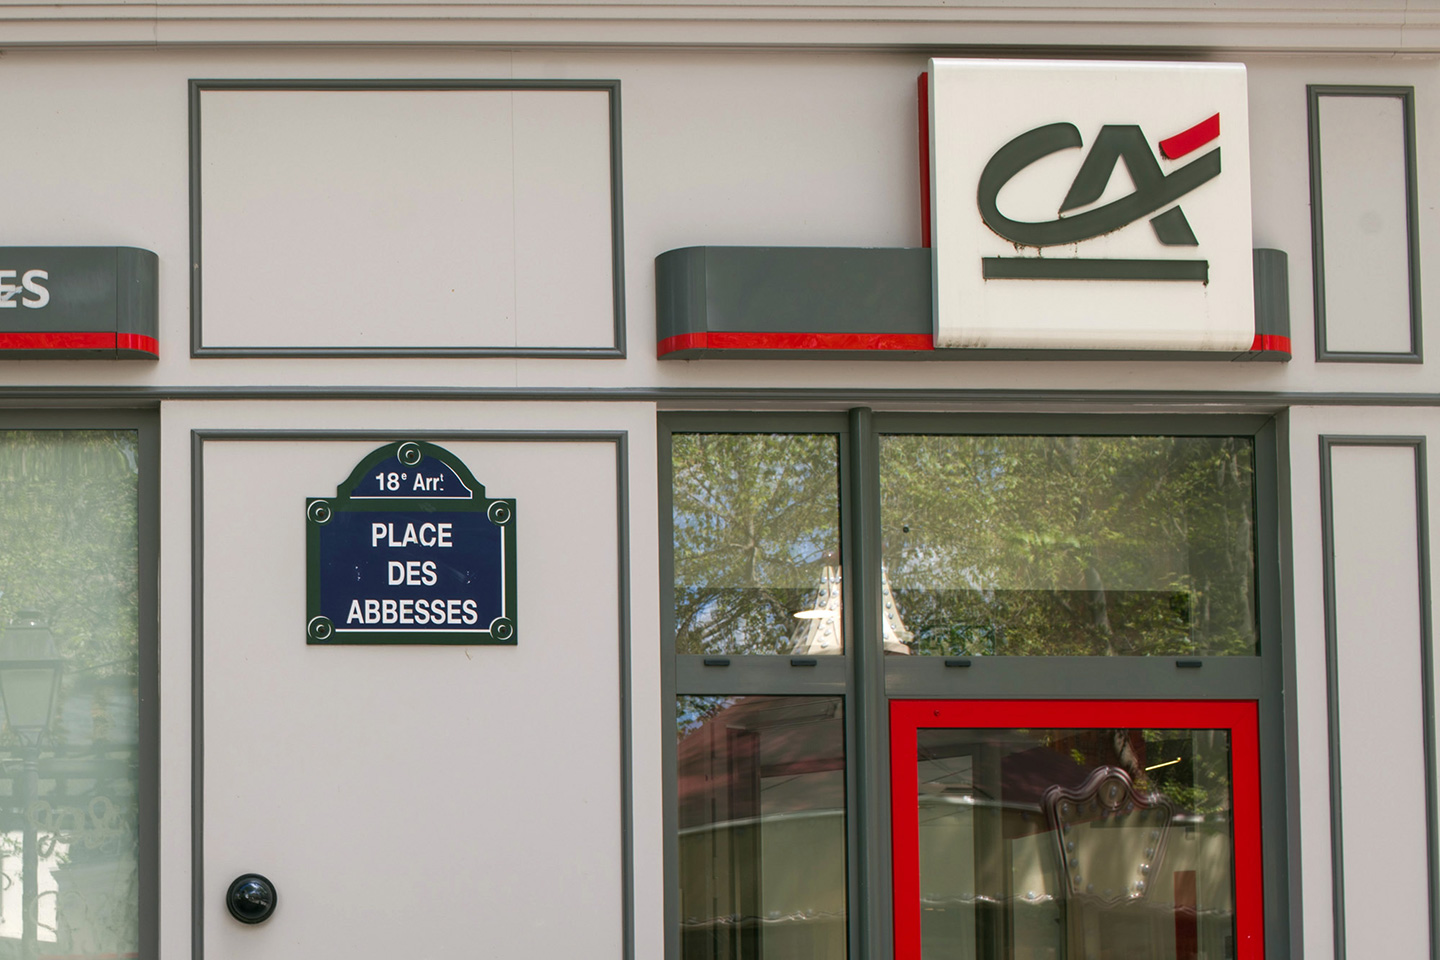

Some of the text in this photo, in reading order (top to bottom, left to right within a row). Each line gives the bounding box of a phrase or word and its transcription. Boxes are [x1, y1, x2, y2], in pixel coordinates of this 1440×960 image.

[371, 522, 453, 548] PLACE
[388, 561, 438, 586] DES
[346, 599, 479, 625] ABBESSES
